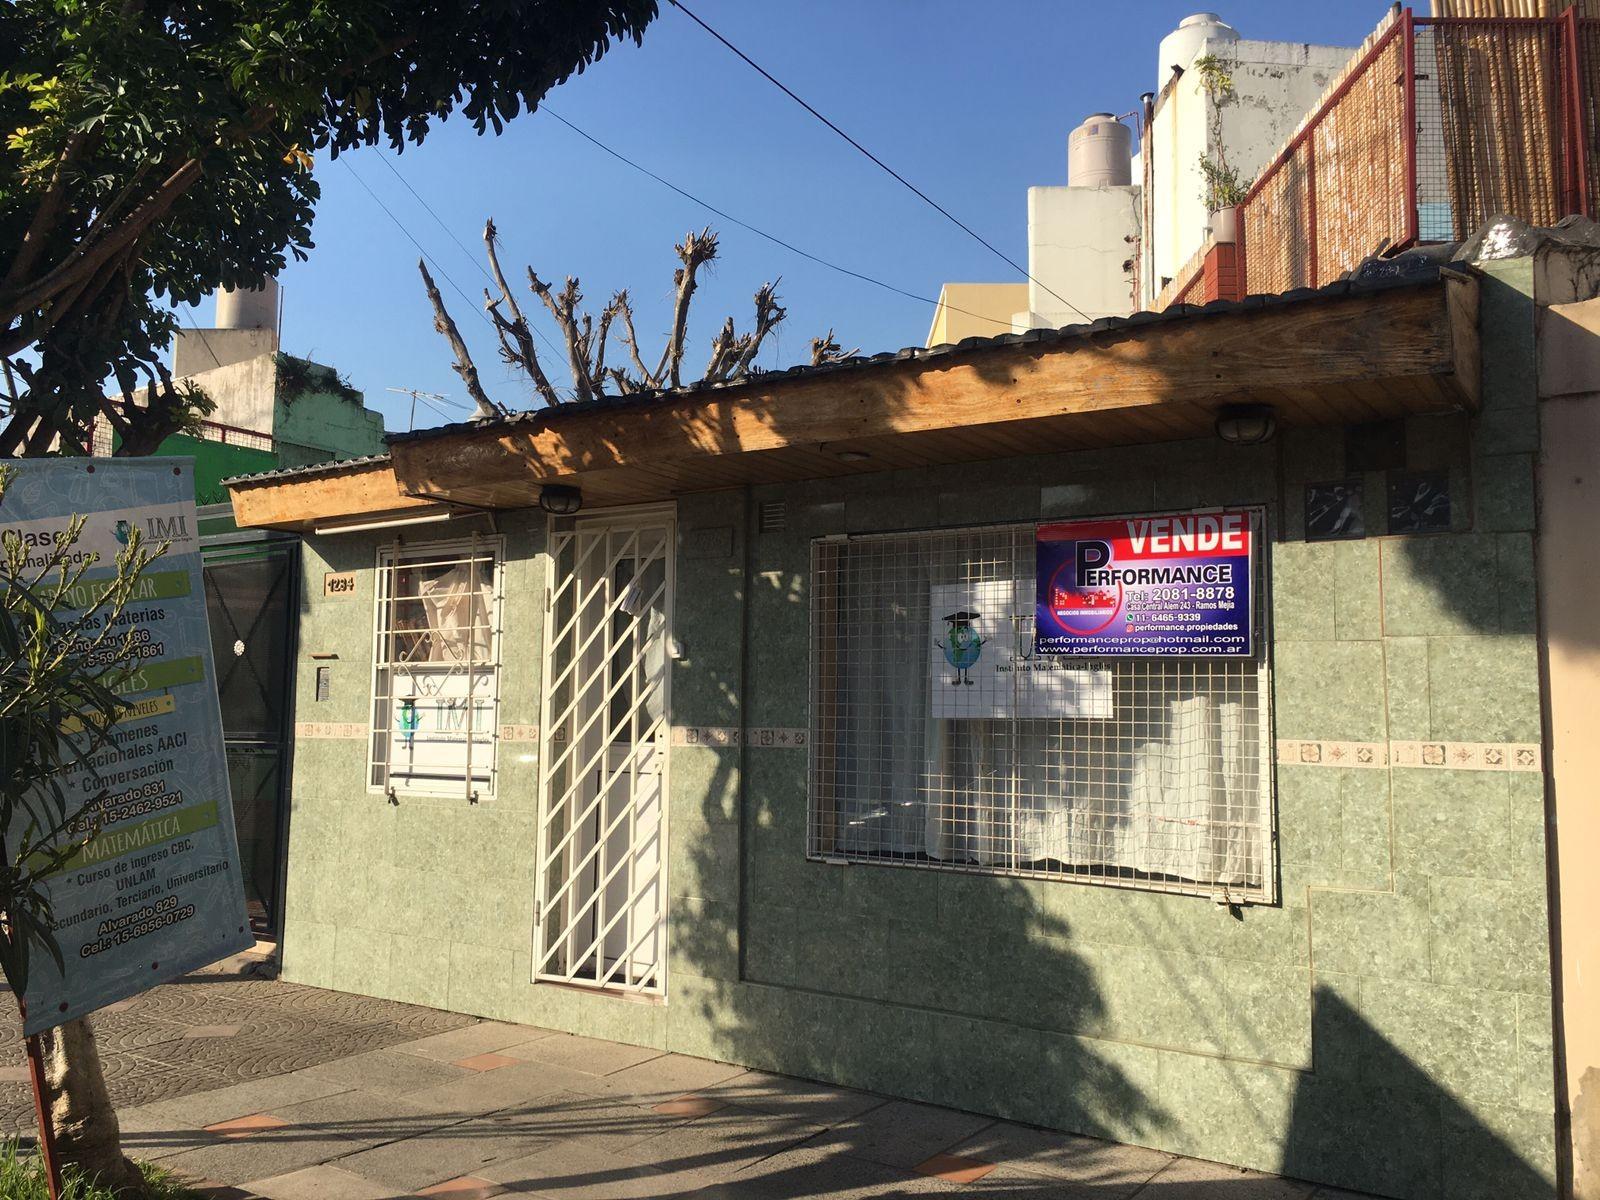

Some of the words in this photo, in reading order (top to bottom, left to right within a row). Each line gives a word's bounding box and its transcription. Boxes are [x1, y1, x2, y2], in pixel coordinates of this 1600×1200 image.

[146, 516, 188, 540] IMI
[1126, 515, 1243, 554] VENDE
[1075, 540, 1232, 587] PERFORMANCE
[1126, 591, 1149, 602] Tel:
[1151, 587, 1236, 602] 2081-8878
[1126, 602, 1141, 611] Casa
[1142, 601, 1163, 611] Central
[1180, 601, 1191, 610] 243
[1196, 601, 1217, 610] Ramos
[1134, 622, 1239, 632] performance.propiedades
[1151, 613, 1202, 622] 6465-9339
[1039, 635, 1246, 645] performanceprop@hotmail.com
[1039, 644, 1243, 654] www.performanceprop.com.ar
[158, 731, 187, 752] AACI
[82, 758, 174, 794] Conversación
[142, 780, 166, 799] 831
[101, 791, 184, 825] 15-2462-9521
[82, 816, 181, 864] MATEMÁTICA
[77, 866, 111, 887] Curso
[113, 861, 128, 876] de
[130, 849, 169, 871] ingreso
[115, 867, 156, 892] UNLAM
[166, 860, 230, 891] Universitario
[97, 905, 155, 937] Alvarado
[155, 895, 178, 914] 829
[79, 937, 112, 959] Cel.:
[112, 904, 195, 947] 15-6956-0729
